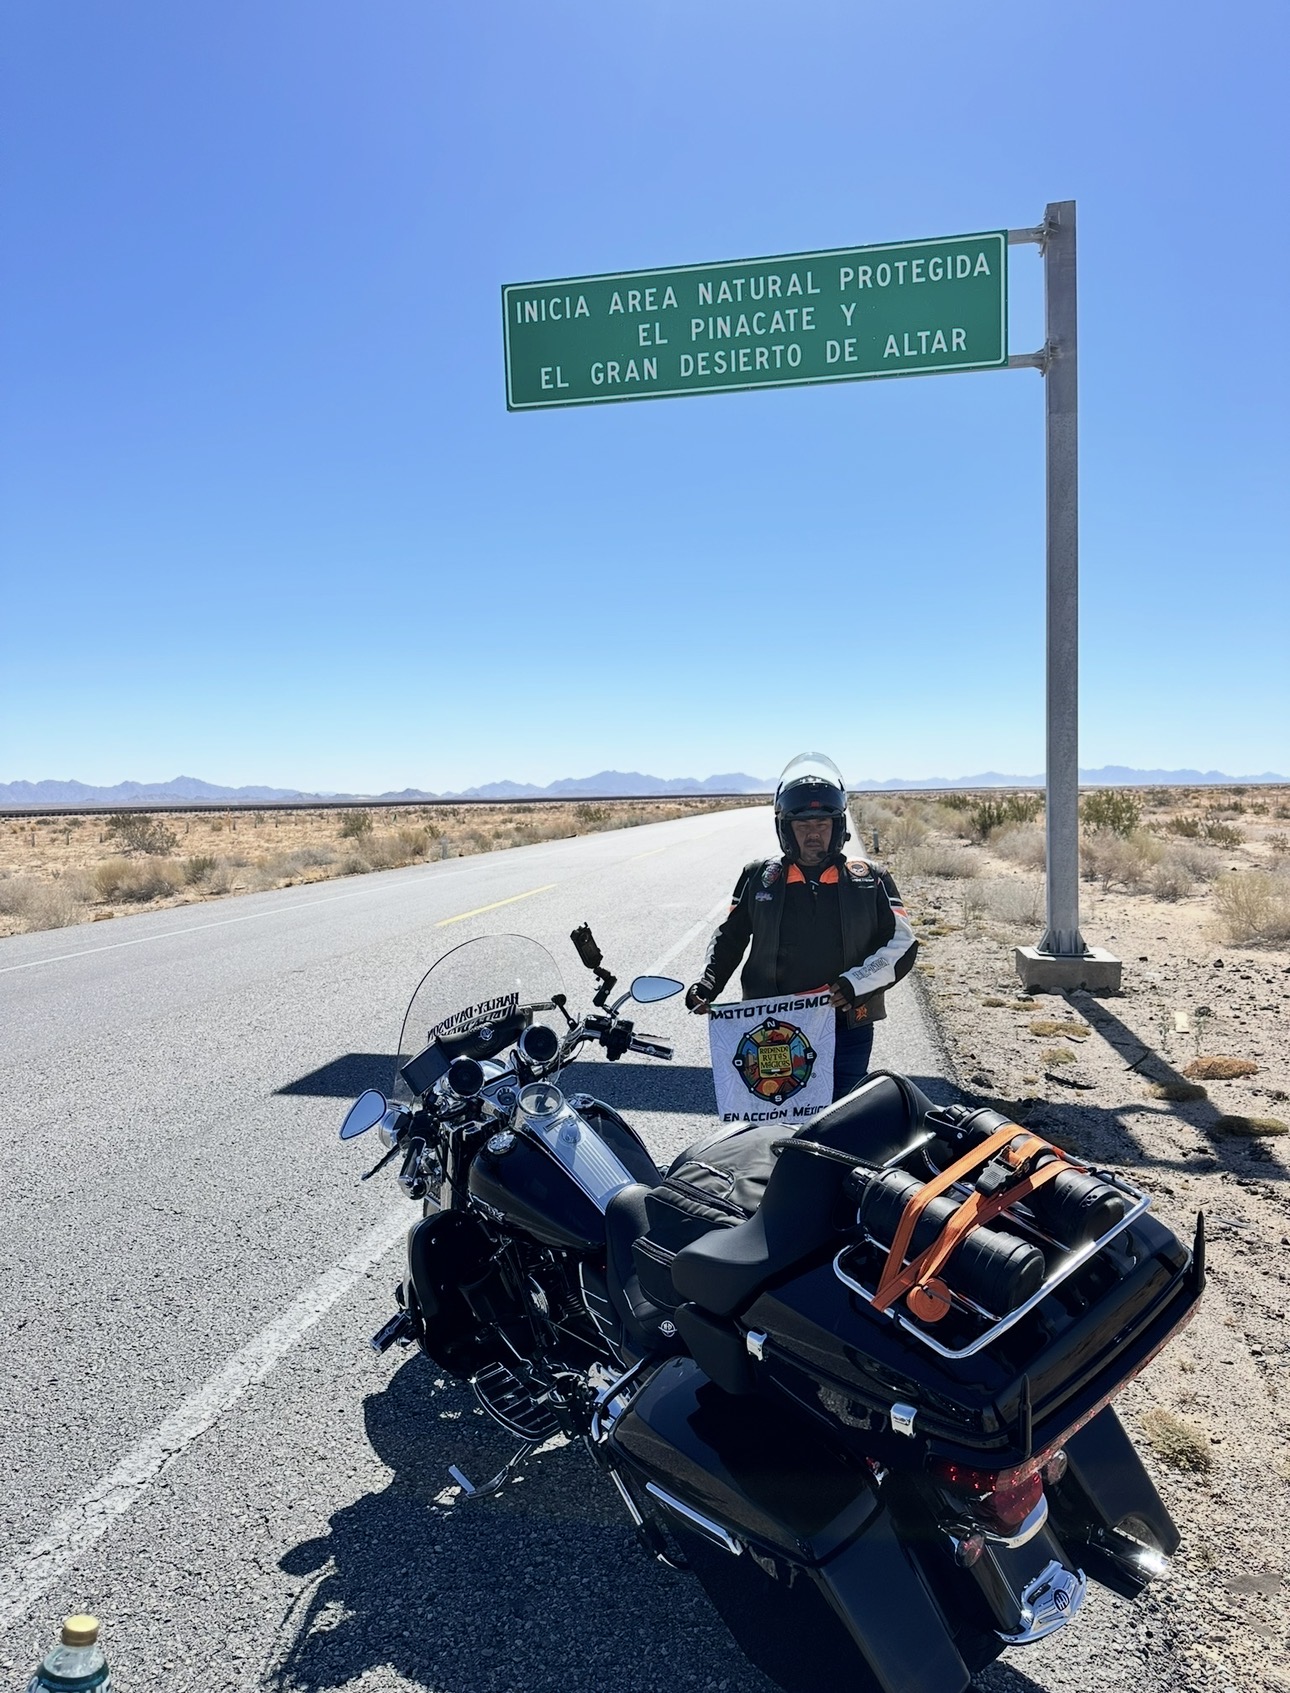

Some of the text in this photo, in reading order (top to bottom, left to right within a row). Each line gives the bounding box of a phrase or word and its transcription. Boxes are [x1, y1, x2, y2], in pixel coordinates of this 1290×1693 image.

[516, 252, 992, 324] INICIA AREA NATURAL PROTEGIDA
[638, 302, 857, 346] EL PINACATE Y
[541, 328, 966, 389] EL GRAN DESIERTO DE ALTAR
[710, 994, 831, 1020] MOTOTURISMO
[734, 1059, 743, 1067] O
[723, 1112, 740, 1122] EN
[743, 1108, 788, 1122] ACCIÓN
